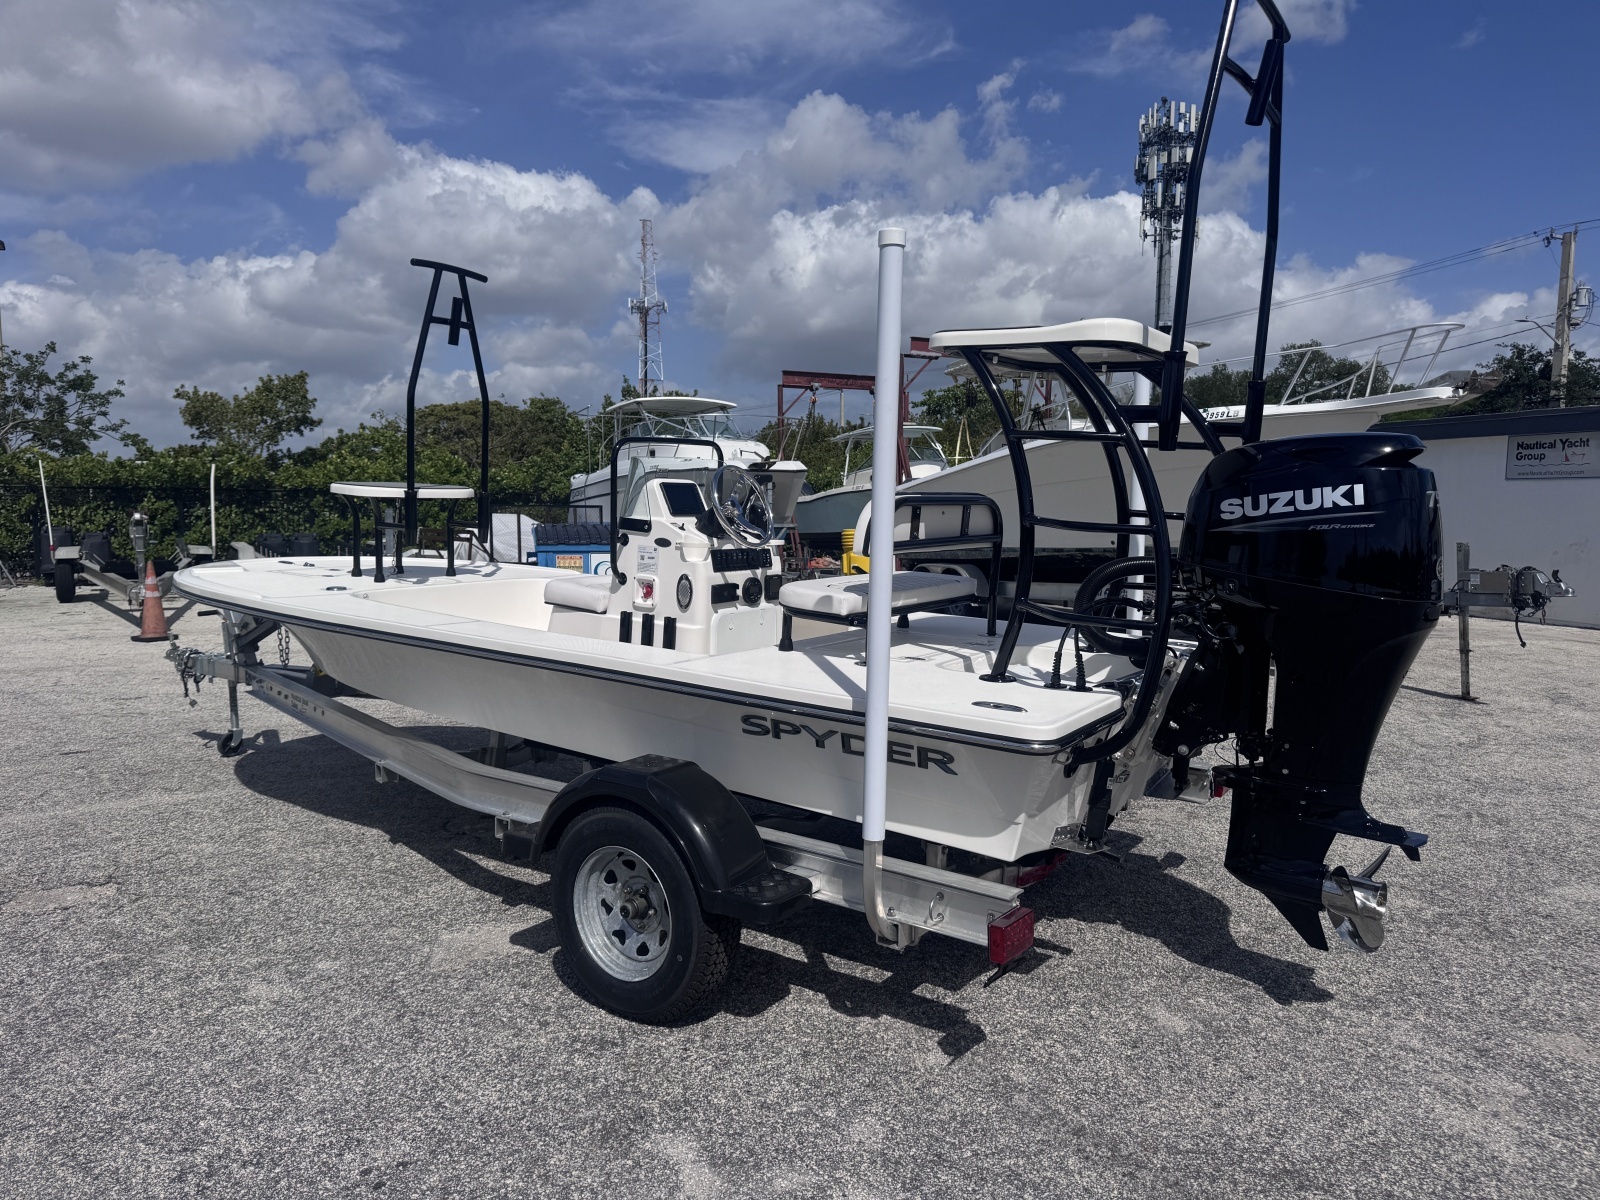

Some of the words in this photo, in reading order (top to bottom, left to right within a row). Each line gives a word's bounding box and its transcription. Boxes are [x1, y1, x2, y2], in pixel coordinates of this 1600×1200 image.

[1516, 439, 1556, 450] Nautical
[1559, 438, 1590, 452] Yacht
[1516, 452, 1546, 462] Group
[1220, 483, 1365, 520] SUZUKI
